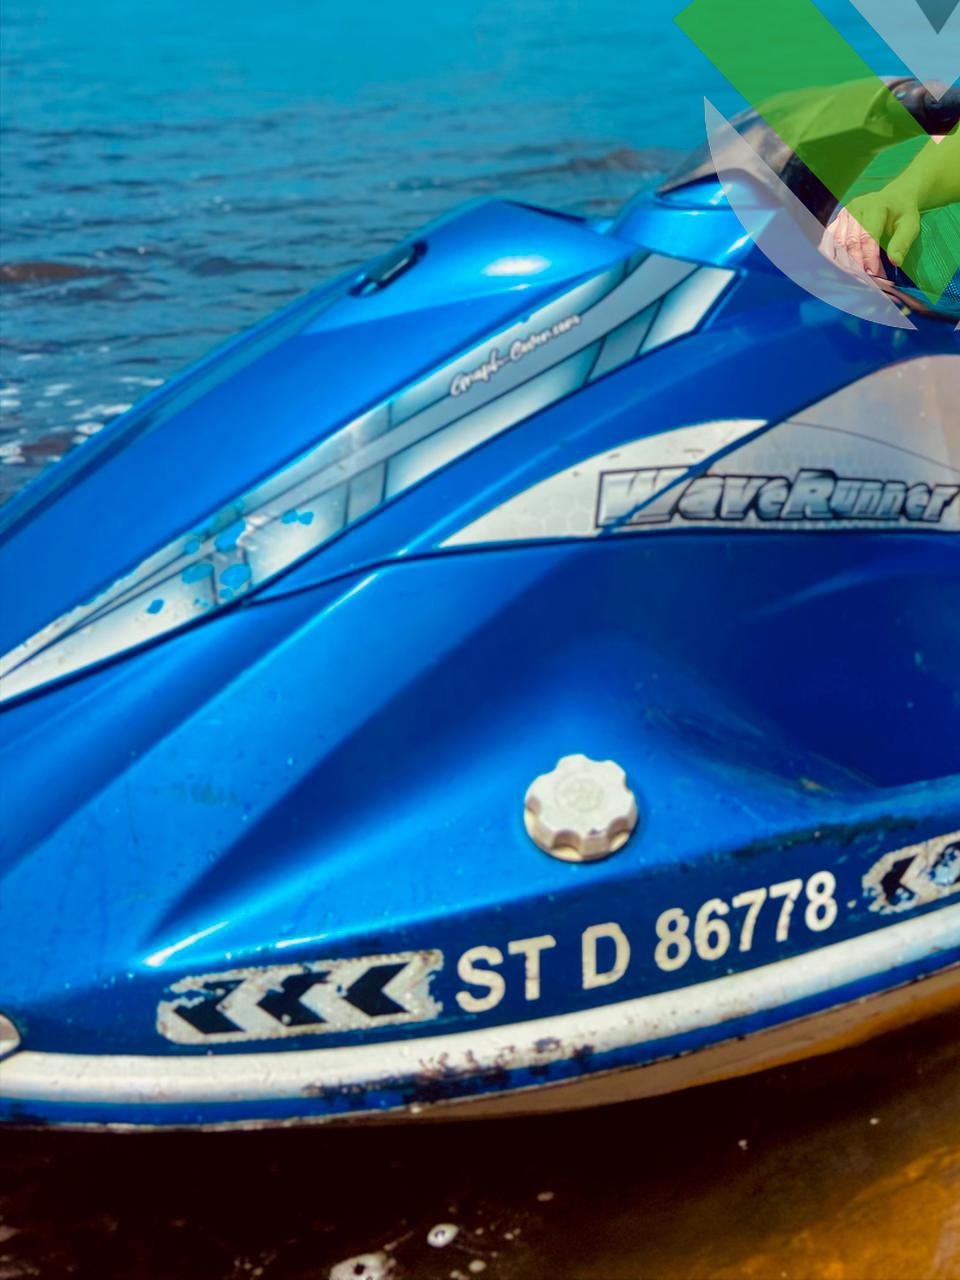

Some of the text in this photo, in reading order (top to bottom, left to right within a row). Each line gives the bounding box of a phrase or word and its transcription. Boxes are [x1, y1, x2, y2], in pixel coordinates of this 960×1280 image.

[455, 870, 838, 1013] ST D 86778
